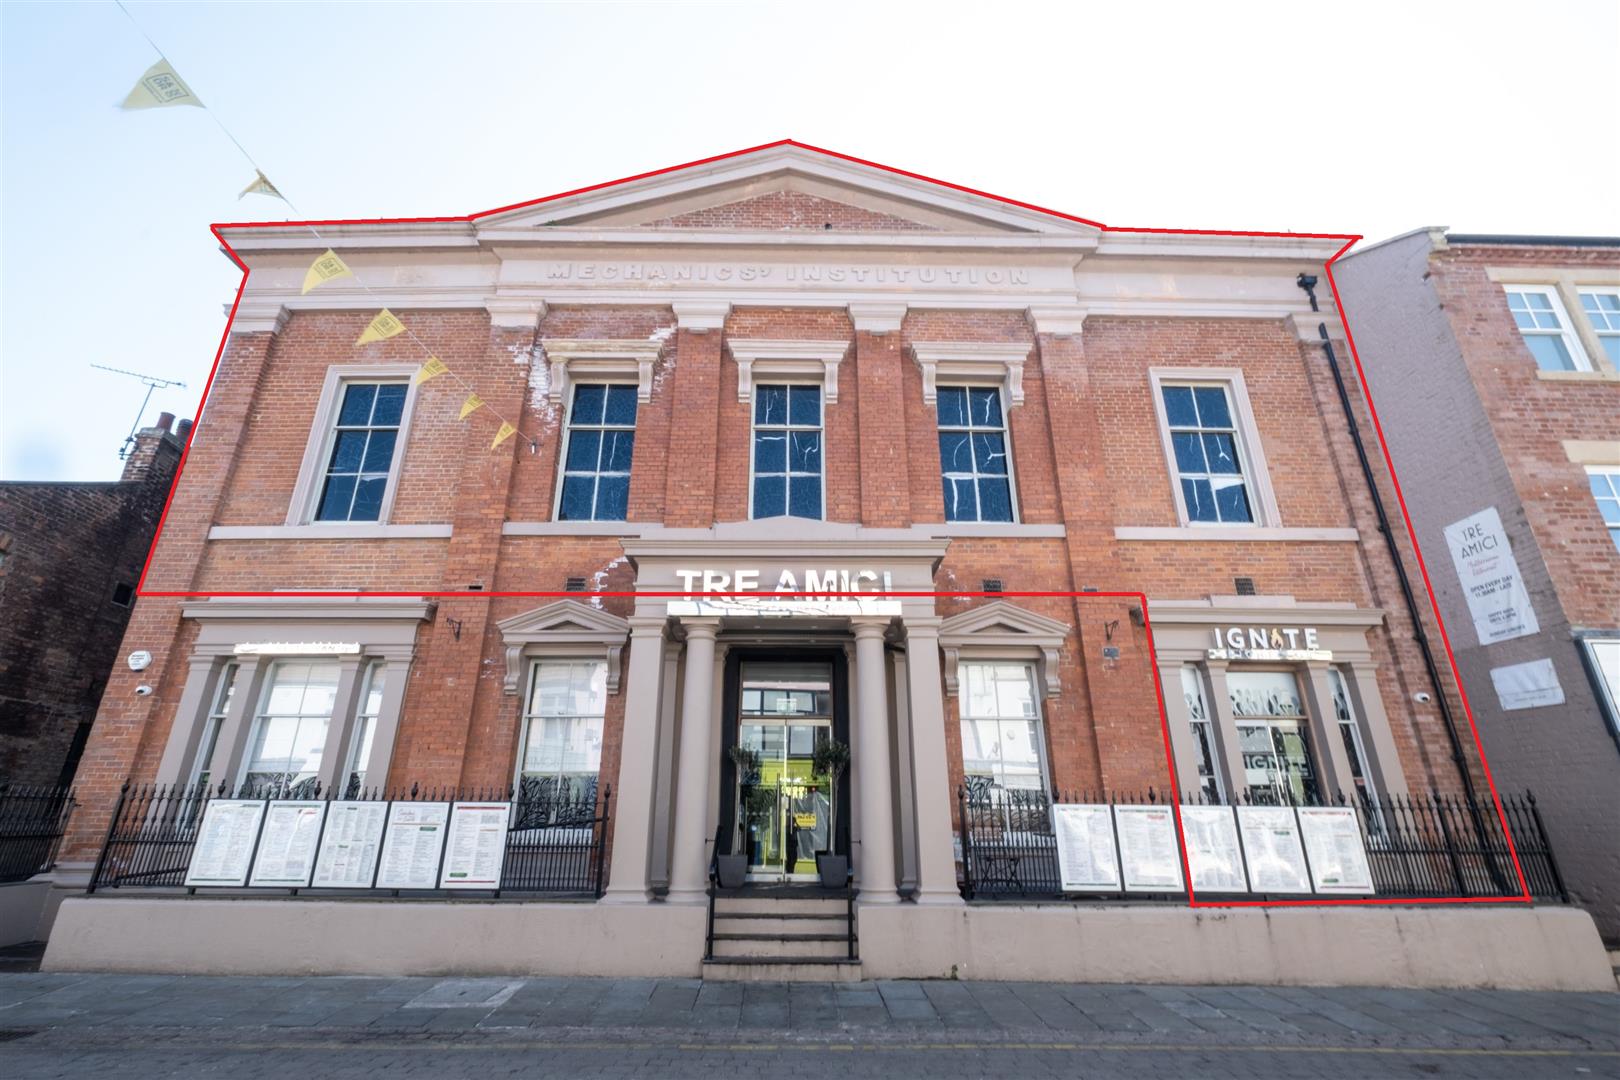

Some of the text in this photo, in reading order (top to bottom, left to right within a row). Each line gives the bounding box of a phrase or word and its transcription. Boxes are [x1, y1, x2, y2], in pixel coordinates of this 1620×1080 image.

[786, 264, 1031, 285] INSTITUTION
[1462, 522, 1484, 541] TRE
[1461, 534, 1498, 559] AMICI
[676, 569, 893, 602] TRE AMICI
